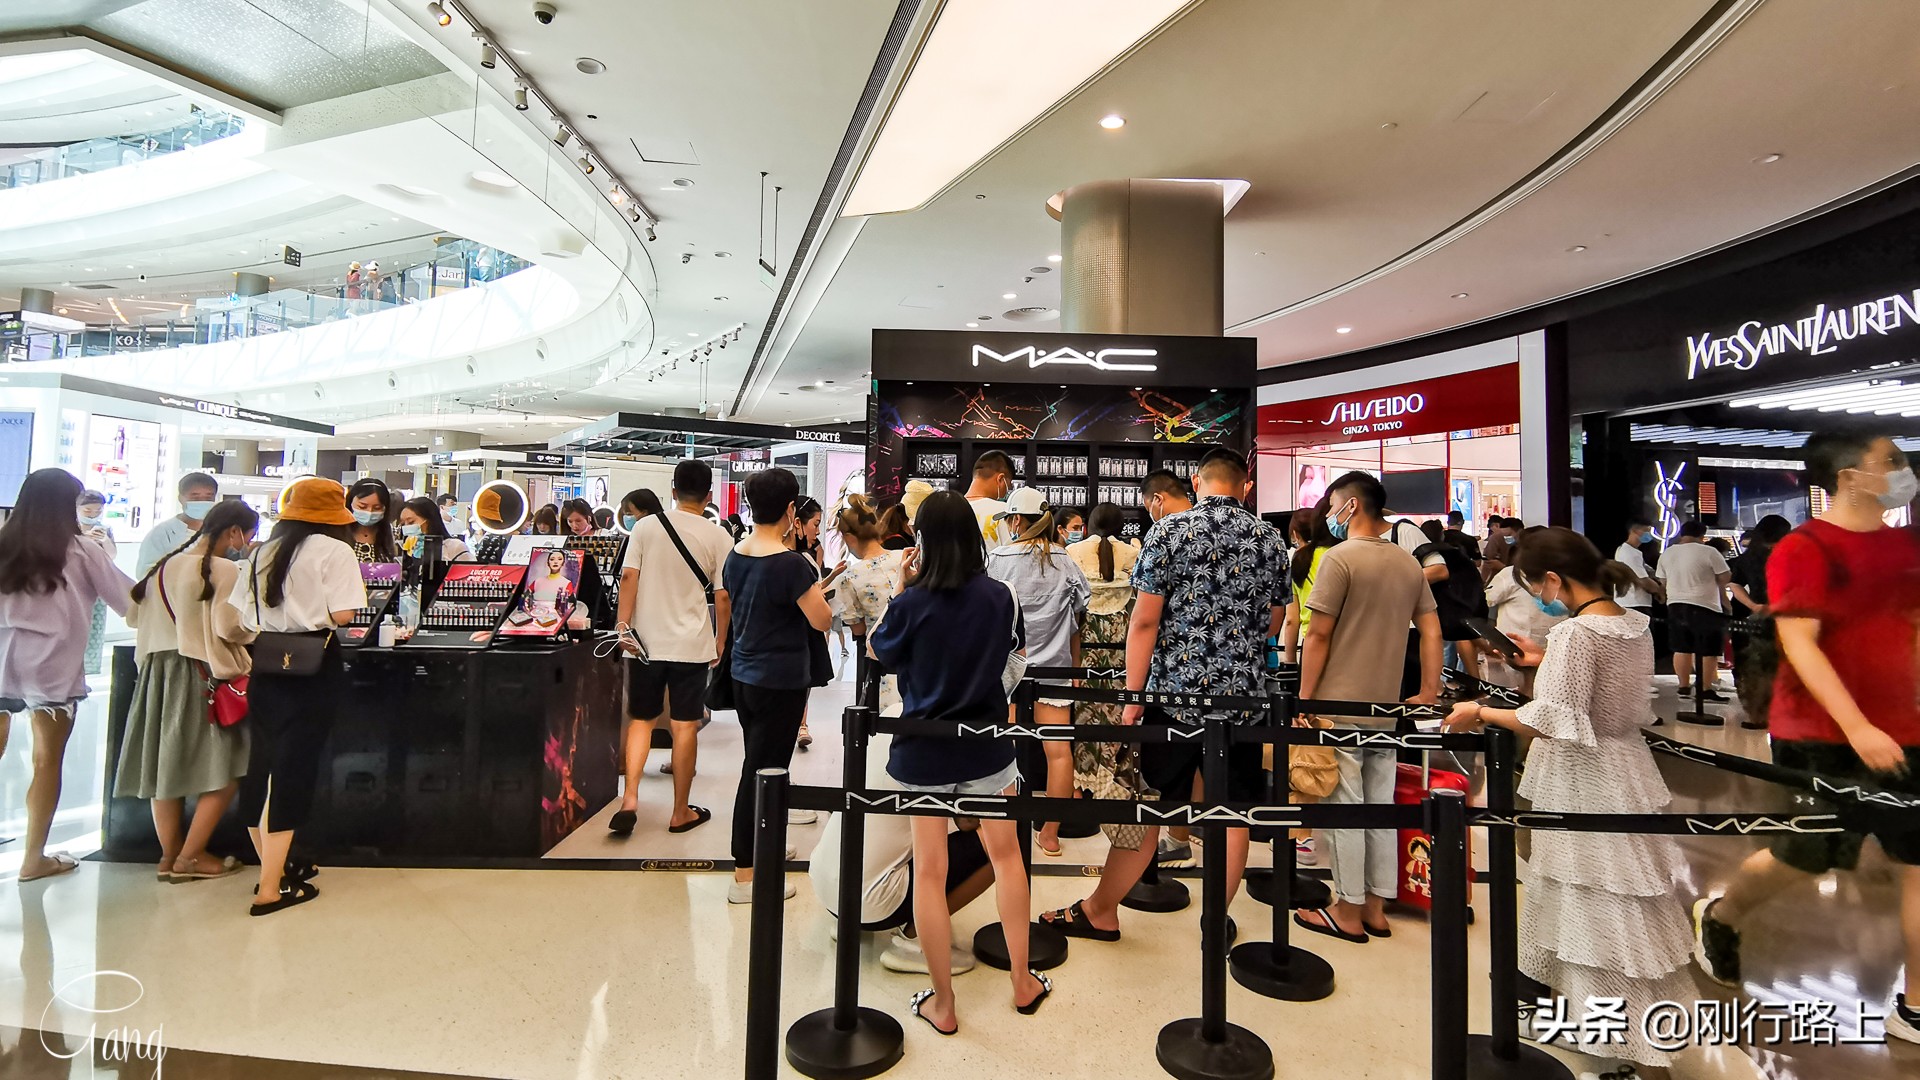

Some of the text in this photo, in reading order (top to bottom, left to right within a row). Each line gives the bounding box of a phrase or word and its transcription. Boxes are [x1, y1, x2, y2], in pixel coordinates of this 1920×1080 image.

[196, 400, 239, 419] CLINIQUE
[1321, 393, 1425, 426] SHISEIDO
[1342, 420, 1403, 435] GINZA TOKYO
[795, 430, 841, 443] DECORTÉ
[732, 460, 766, 473] GIORGIO
